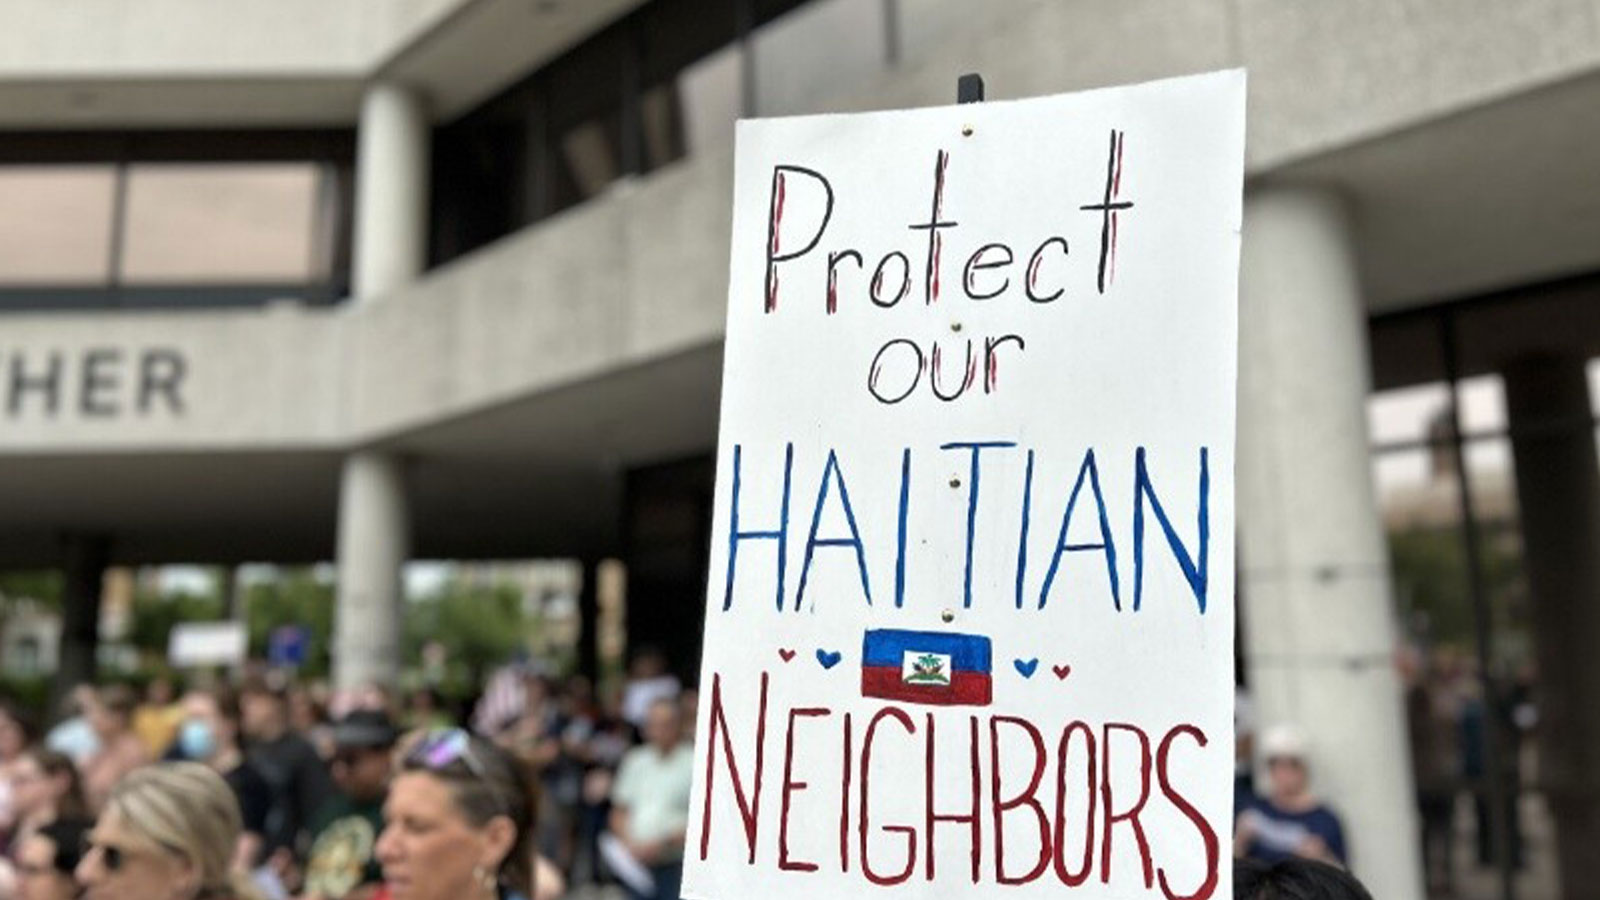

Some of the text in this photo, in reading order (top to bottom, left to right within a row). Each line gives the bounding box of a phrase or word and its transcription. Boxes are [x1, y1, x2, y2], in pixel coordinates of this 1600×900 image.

[765, 129, 1134, 314] Protect
[0, 347, 188, 417] HER
[868, 333, 1025, 404] our
[723, 441, 1208, 613] HAITIAN
[700, 671, 1219, 900] NEIGHBORS
